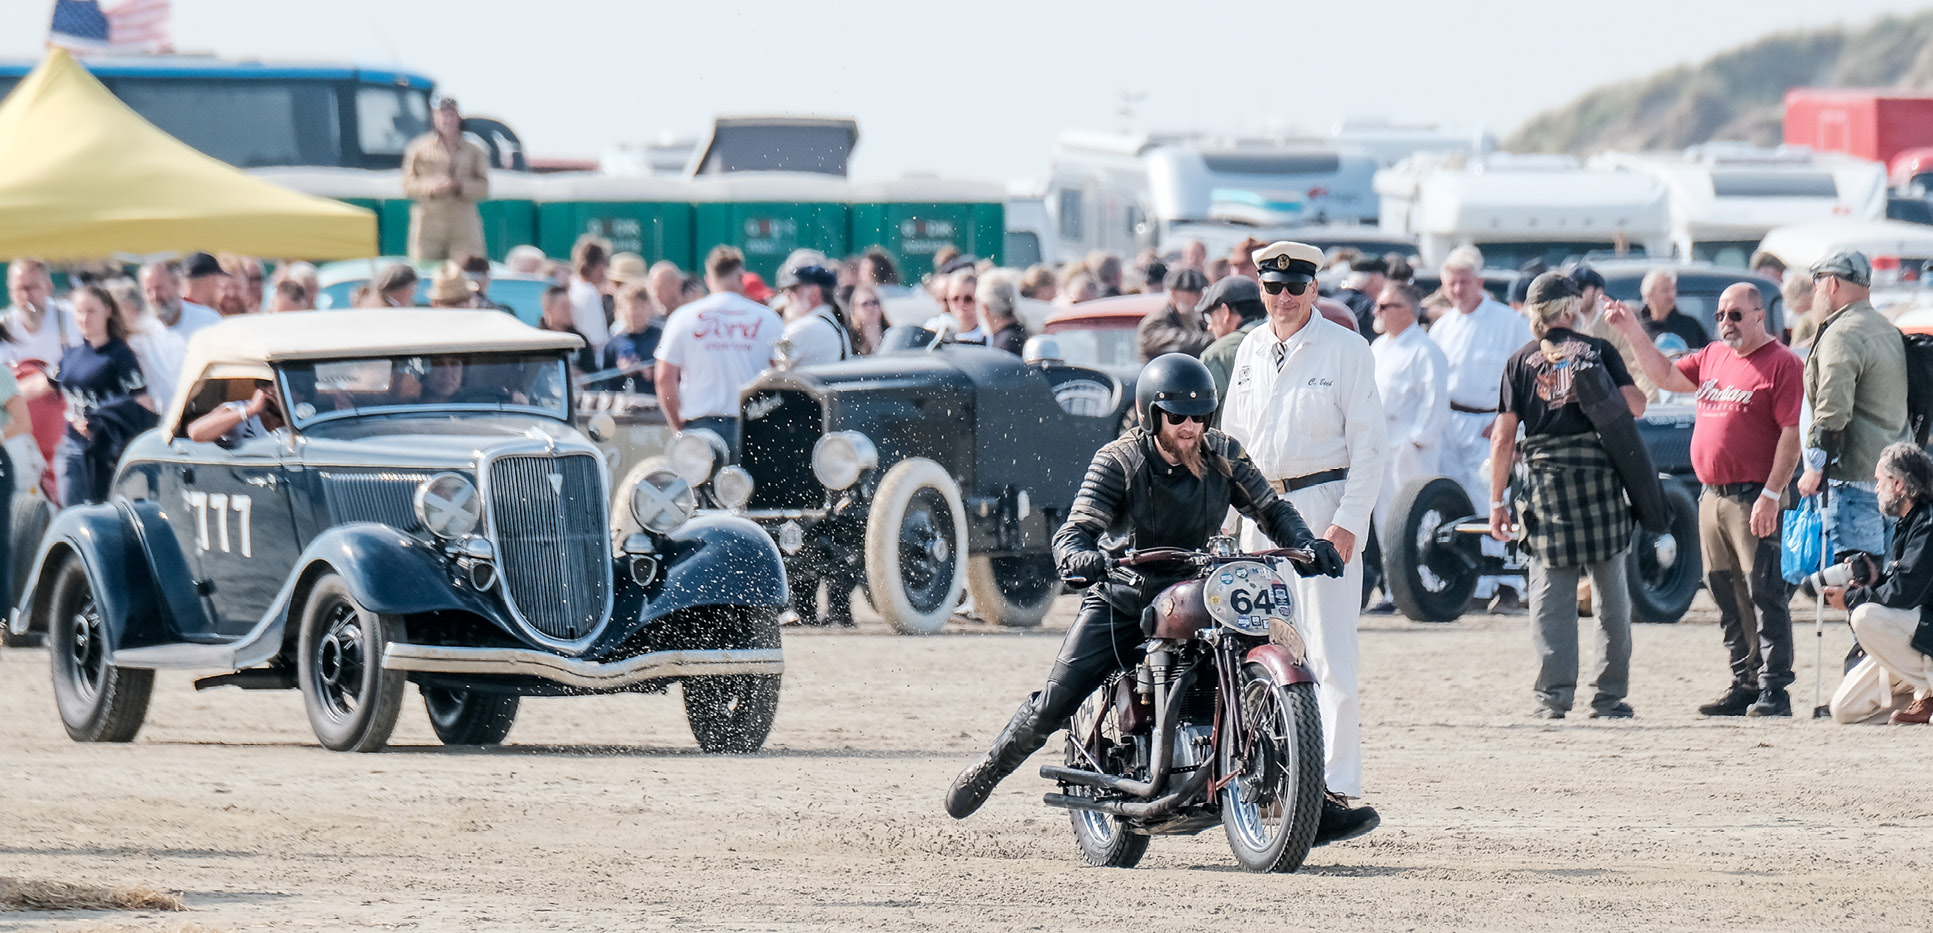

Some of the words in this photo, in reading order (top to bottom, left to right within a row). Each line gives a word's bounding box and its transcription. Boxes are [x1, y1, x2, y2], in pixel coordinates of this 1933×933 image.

[693, 309, 763, 339] Ford
[1696, 379, 1754, 405] Indian
[182, 488, 252, 558] 777
[1230, 588, 1276, 615] 64
